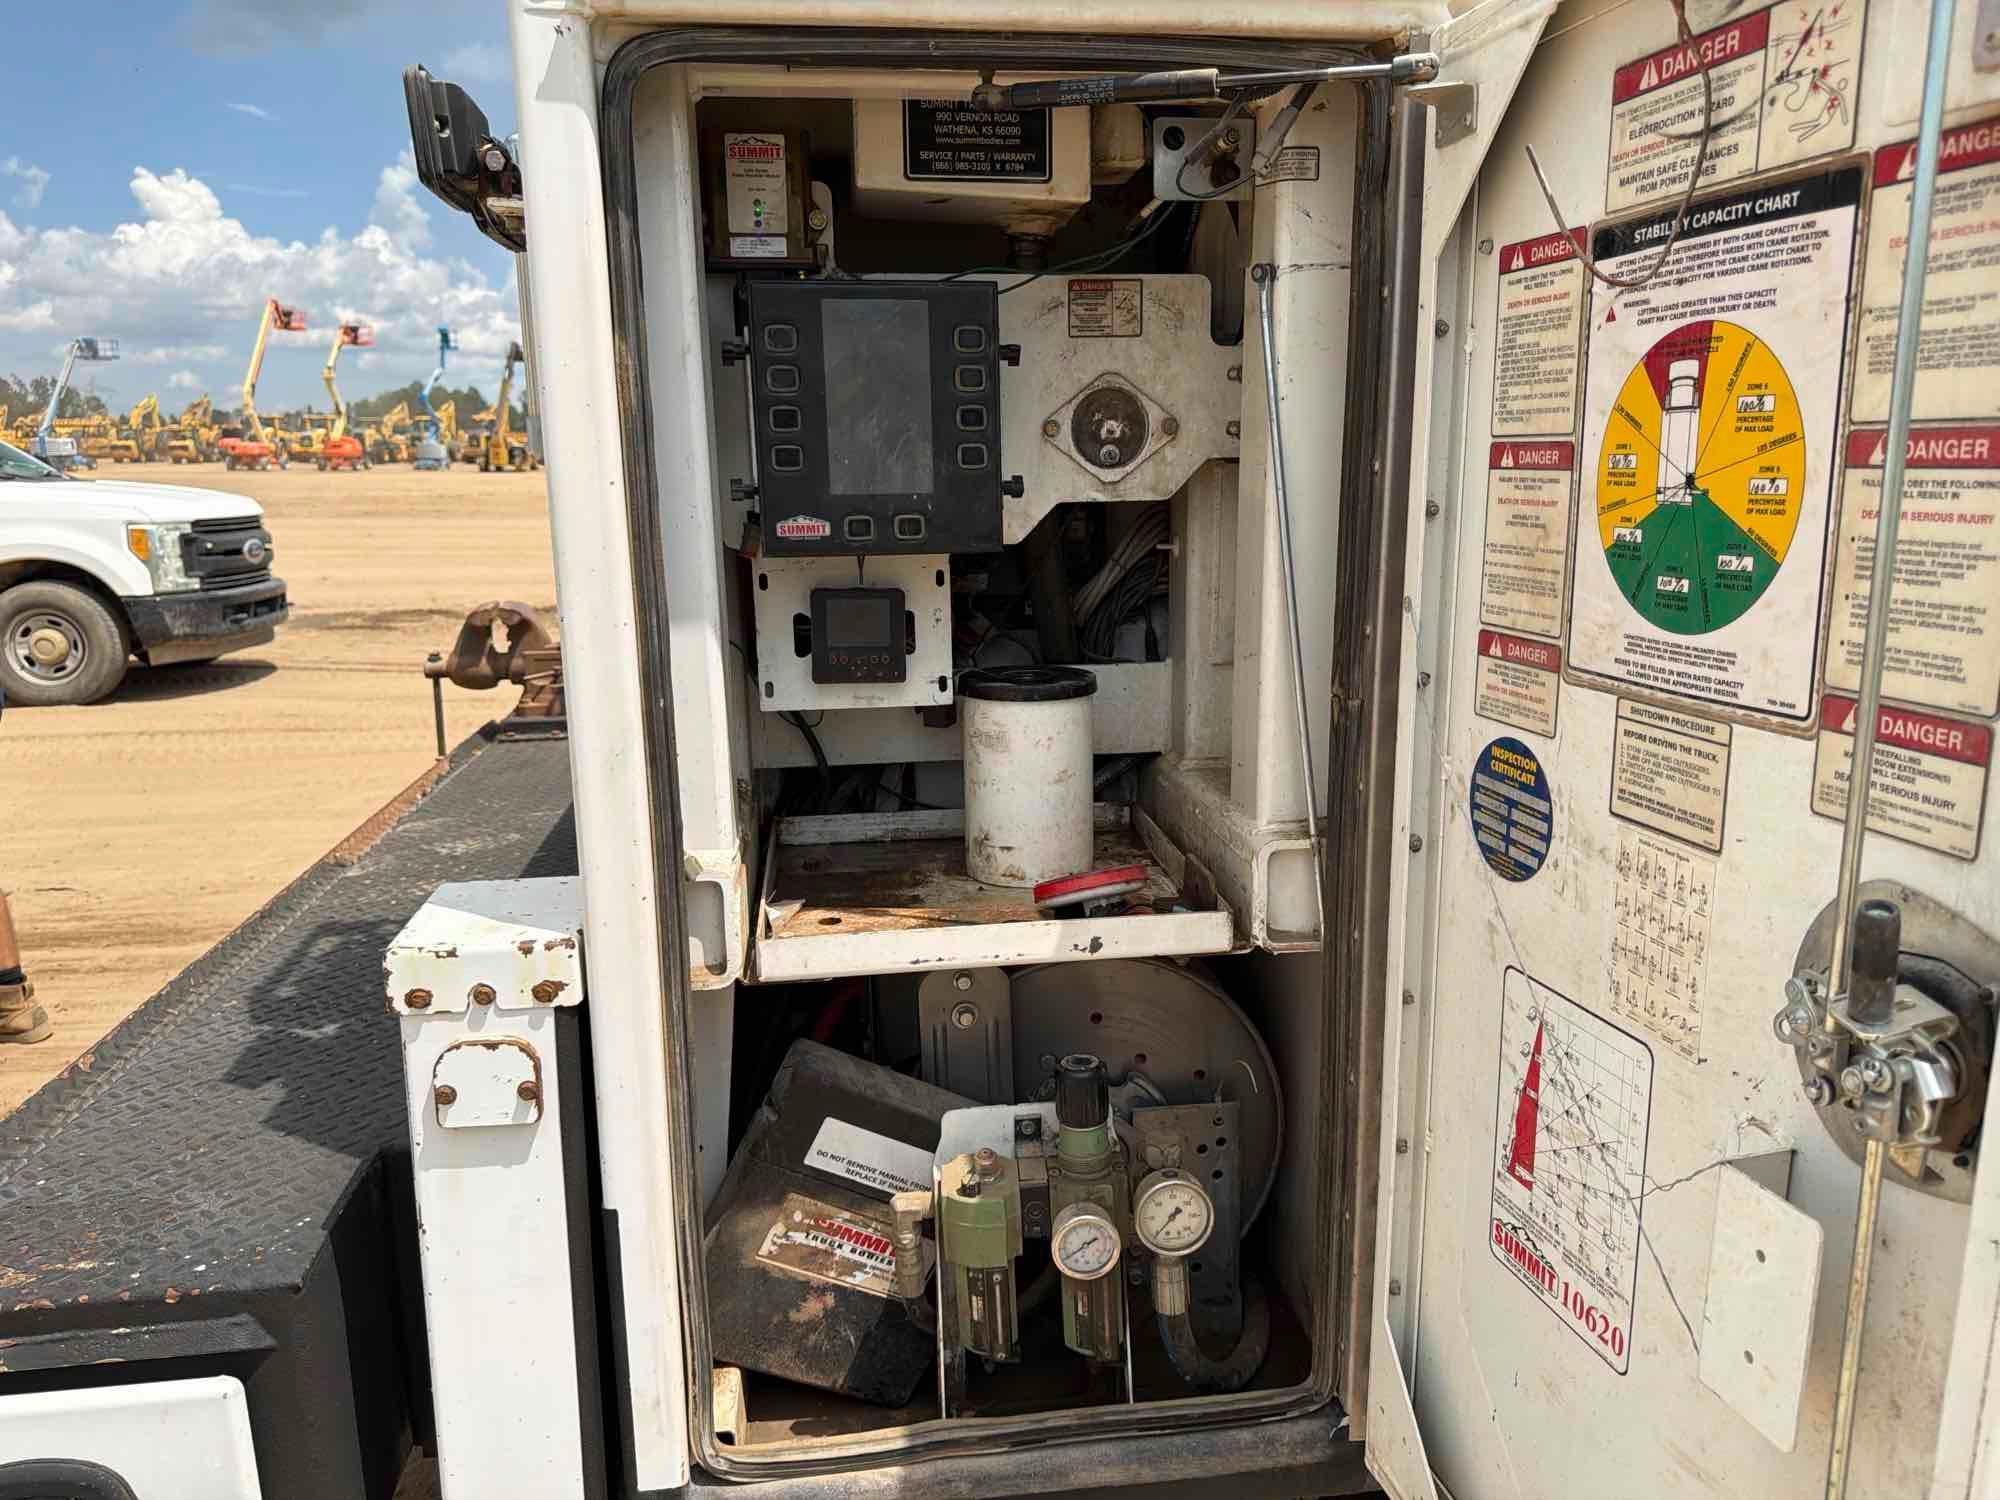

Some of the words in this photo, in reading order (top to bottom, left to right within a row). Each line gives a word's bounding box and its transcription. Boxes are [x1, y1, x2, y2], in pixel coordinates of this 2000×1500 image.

[1662, 30, 1740, 79] DANGER
[934, 124, 980, 136] WATHENA,
[982, 126, 993, 134] KS
[996, 126, 1021, 136] 66090
[936, 112, 952, 122] 990
[956, 112, 992, 122] VERNON
[994, 113, 1020, 122] ROAD
[1629, 109, 1695, 140] ELECTROCUTION
[1698, 96, 1734, 116] HZARD
[728, 144, 784, 159] SUMMIT
[1939, 126, 2000, 157] ANGE
[920, 151, 952, 160] SERVICE
[960, 152, 985, 160] PARTS
[993, 152, 1036, 161] WARRANTY
[1619, 170, 1654, 187] MAINTAIN
[1657, 162, 1678, 176] SAFE
[1679, 143, 1739, 169] CLERANCES
[1635, 179, 1658, 195] FROM
[1659, 172, 1689, 189] POWER
[1634, 217, 1690, 243] STABILIY
[1692, 202, 1753, 229] CAPACITY
[1755, 191, 1800, 214] CHART
[1531, 240, 1572, 261] DANGER
[1616, 257, 1637, 269] LIFTING
[1674, 241, 1712, 255] DETERMINED
[1713, 239, 1720, 247] BY
[1723, 235, 1740, 243] BOTH
[1741, 231, 1763, 241] CRANE
[1765, 223, 1799, 237] CAPACITY
[1801, 221, 1816, 229] AND
[1671, 256, 1684, 266] AND
[1685, 249, 1720, 263] THEREFORE
[1722, 246, 1745, 256] VARIES
[1746, 241, 1764, 250] WITH
[1766, 237, 1789, 247] CRANE
[1791, 230, 1830, 242] ROTATION.
[1675, 265, 1696, 275] ALONG
[1696, 261, 1714, 271] WITH
[1715, 259, 1727, 268] THE
[1728, 254, 1749, 265] CRANE
[1751, 248, 1785, 260] CAPACITY
[1786, 244, 1810, 255] CHART
[1811, 242, 1822, 250] TO
[1649, 279, 1671, 290] LIFTING
[1703, 271, 1716, 280] FOR
[1717, 267, 1745, 277] VARIOUS
[1747, 263, 1768, 272] CRANE
[1771, 255, 1813, 268] ROTATIONS.
[1637, 306, 1660, 316] LIFTING
[1661, 301, 1679, 312] LOADS
[1681, 297, 1707, 309] GREATER
[1709, 296, 1726, 305] THAN
[1728, 292, 1742, 302] THIS
[1744, 288, 1777, 299] CAPACITY
[1637, 316, 1655, 326] CHART
[1669, 311, 1687, 321] CAUSE
[1688, 306, 1716, 318] SERIOUS
[1717, 304, 1741, 314] INJURY
[1742, 301, 1752, 310] OR
[1753, 299, 1777, 309] DEATH.
[1747, 383, 1763, 391] ZONE
[1736, 415, 1775, 424] PERCENTAGE
[1757, 425, 1774, 433] LOAD
[1768, 432, 1798, 449] DEGREES
[1905, 439, 1989, 460] DANGER
[1518, 450, 1560, 464] DANGER
[1907, 480, 1929, 488] OBEY
[1930, 480, 1948, 488] THE
[1917, 491, 1949, 500] RESULT
[1951, 492, 1960, 500] IN
[1756, 508, 1768, 516] MAX
[1910, 511, 1955, 524] SERIOUS
[1956, 513, 1995, 525] INJURY
[779, 524, 826, 537] SUMMIT
[1507, 643, 1548, 664] DANGER
[1626, 669, 1651, 681] ALLOWED
[1652, 674, 1659, 682] IN
[1660, 676, 1671, 685] THE
[1672, 680, 1712, 694] APPROPRIATE
[1714, 688, 1739, 700] REGION.
[1640, 663, 1647, 671] BE
[1648, 665, 1667, 675] FILLED
[1668, 669, 1675, 677] IN
[1676, 670, 1691, 680] WITH
[1693, 674, 1712, 684] RATED
[1713, 678, 1744, 689] CAPACITY
[1630, 706, 1669, 724] SHUTDOWN
[1671, 716, 1715, 735] PROCEDURE
[1880, 716, 1963, 750] DANGER
[1624, 729, 1647, 742] BEFORE
[1648, 736, 1677, 751] DRIVING
[1679, 744, 1692, 755] THE
[1492, 744, 1537, 772] INSPECTION
[1874, 758, 1897, 770] BOOM
[1875, 748, 1922, 766] REEFALLING
[1491, 759, 1536, 786] CERTIFICATE
[1872, 767, 1890, 778] WILL
[1891, 771, 1916, 785] CAUSE
[1879, 783, 1920, 802] SERIOUS
[1921, 794, 1957, 811] INJURY
[816, 1150, 828, 1158] DO
[829, 1153, 846, 1164] NOT
[847, 1158, 878, 1176] REMOVE
[878, 1168, 909, 1189] MANUAL
[909, 1179, 932, 1192] FROM
[845, 1168, 878, 1186] REPLACE
[879, 1178, 887, 1188] IF
[804, 1232, 844, 1251] TRUCK
[850, 1245, 893, 1267] BODIES
[814, 1216, 896, 1259] SUMMI
[1494, 1222, 1556, 1292] SUMMIT
[1560, 1282, 1624, 1356] 10620
